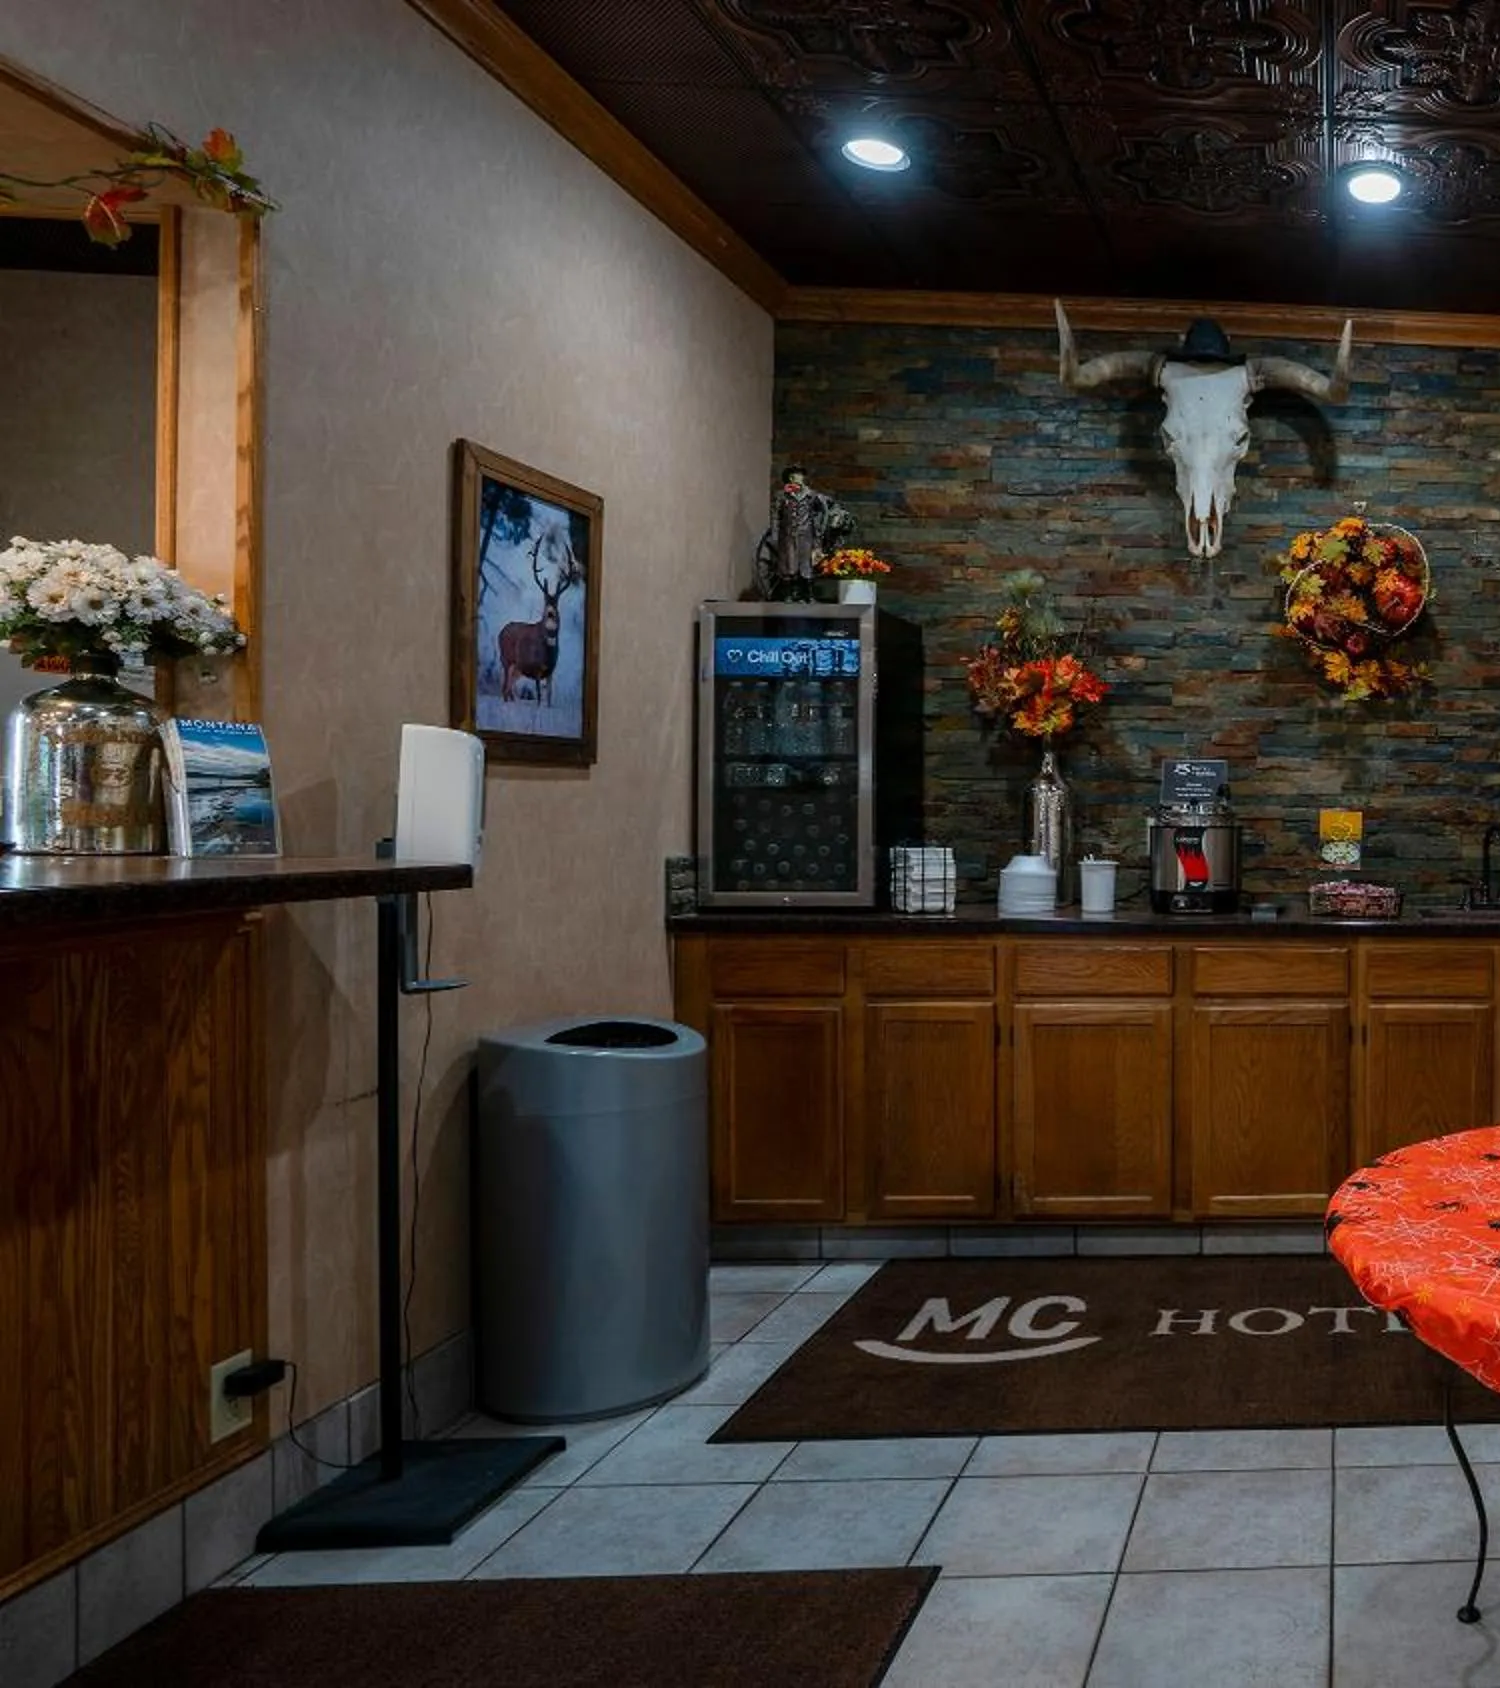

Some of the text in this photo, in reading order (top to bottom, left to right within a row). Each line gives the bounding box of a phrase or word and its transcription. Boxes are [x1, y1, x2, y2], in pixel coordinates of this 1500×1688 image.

[747, 648, 779, 663] Chill
[179, 719, 257, 731] MONTANA
[895, 1295, 1087, 1341] MC
